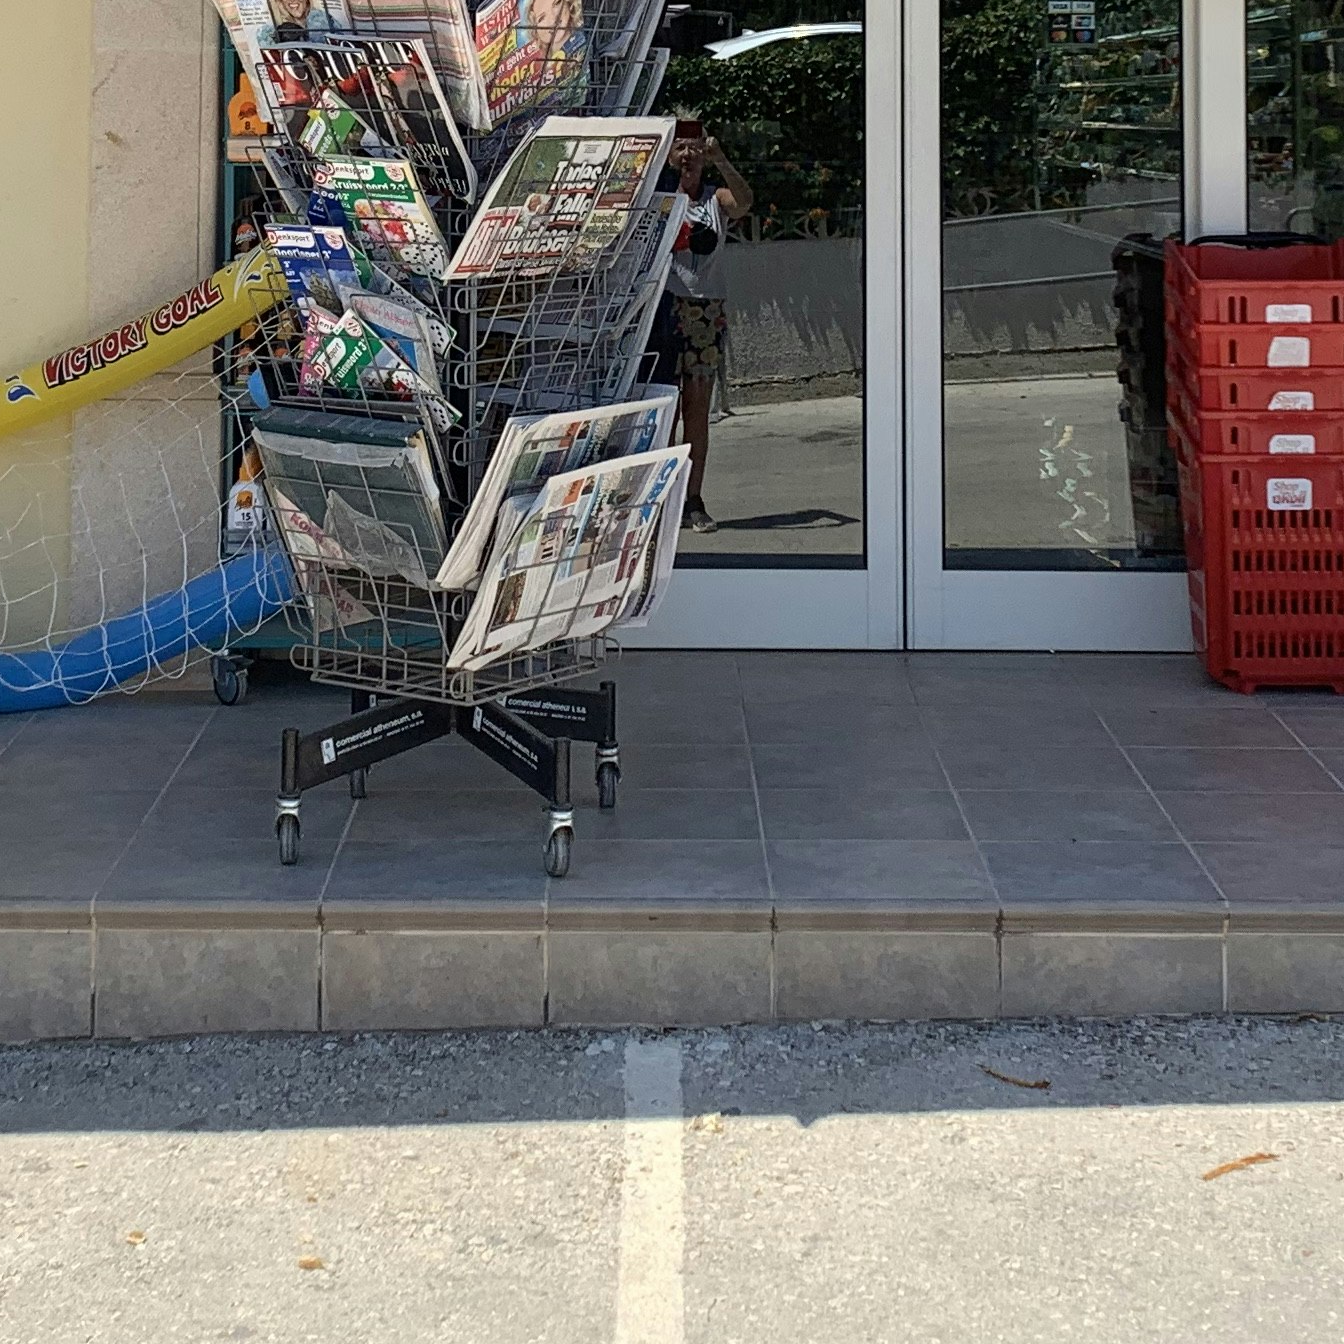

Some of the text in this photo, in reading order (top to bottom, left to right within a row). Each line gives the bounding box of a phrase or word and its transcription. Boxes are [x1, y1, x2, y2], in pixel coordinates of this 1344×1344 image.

[244, 121, 251, 131] 8
[267, 231, 311, 244] Denksport
[42, 277, 224, 389] VICTORY GOAL
[241, 512, 251, 521] 15
[508, 698, 542, 708] comercial
[336, 727, 373, 748] comercial
